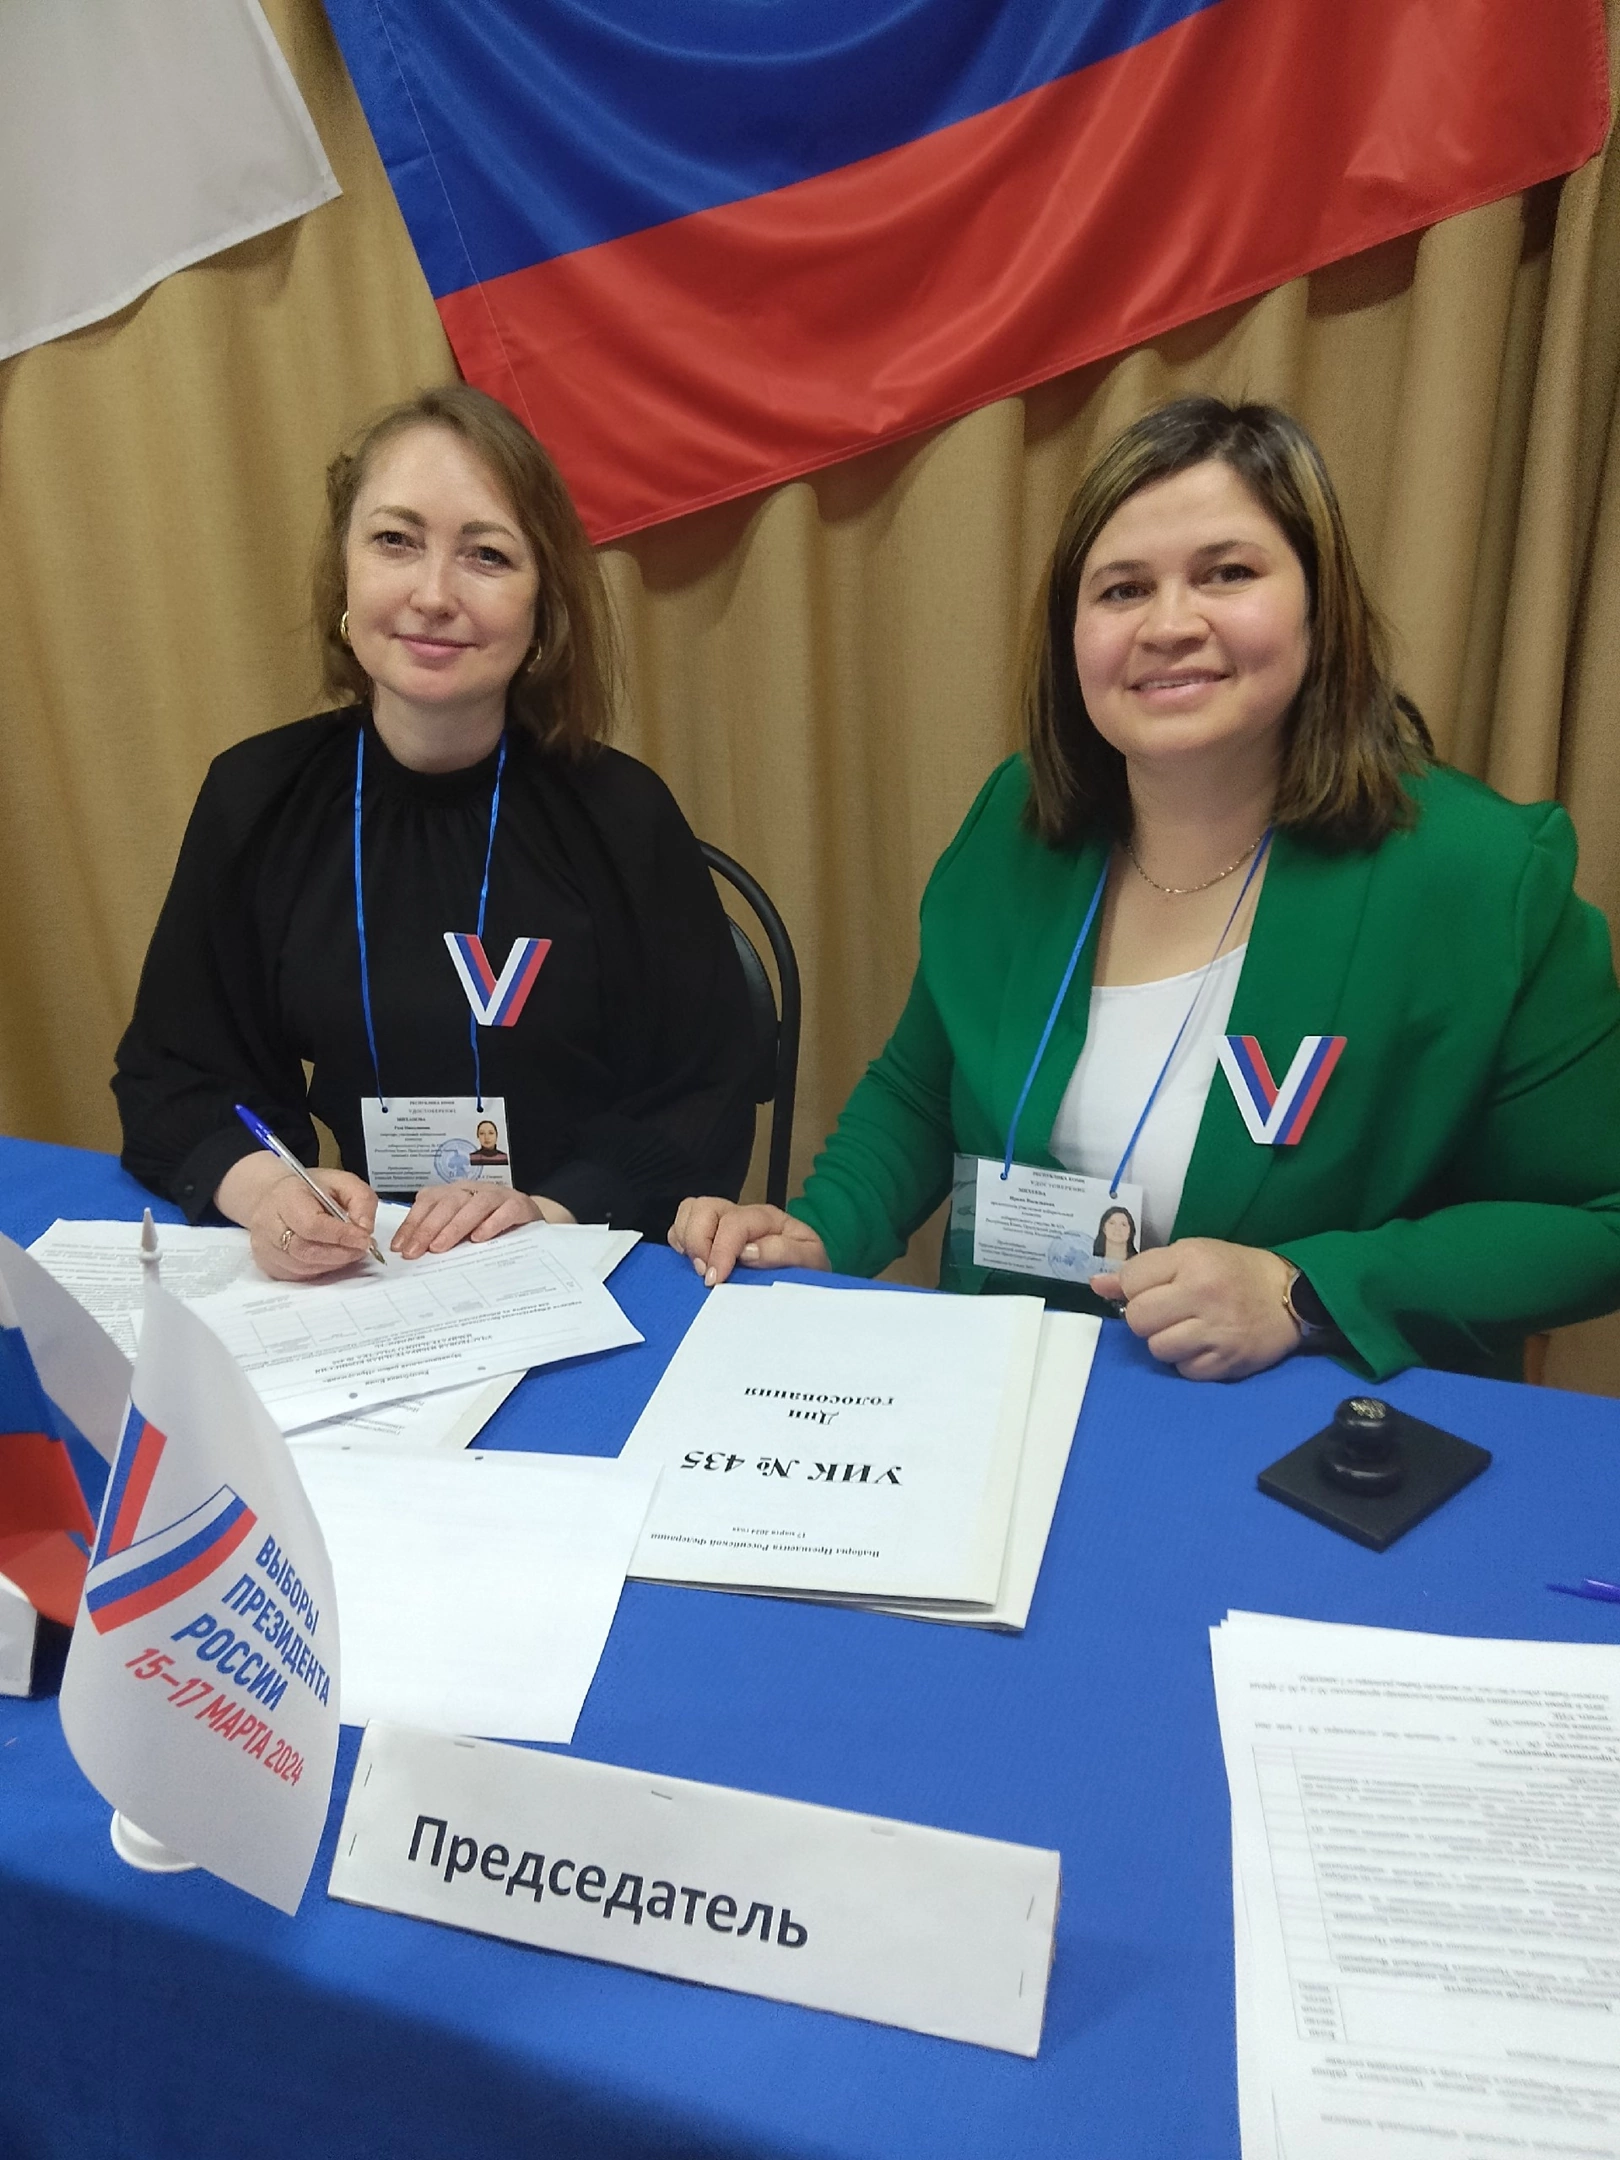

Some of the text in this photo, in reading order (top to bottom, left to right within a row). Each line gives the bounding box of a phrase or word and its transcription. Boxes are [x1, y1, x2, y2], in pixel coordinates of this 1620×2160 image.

[744, 1387, 894, 1406] голосования
[788, 1409, 839, 1425] Дни
[680, 1450, 903, 1486] УИК № 435
[256, 1534, 319, 1636] ВЫБОРЫ
[651, 1533, 879, 1558] Выборы Президента Российской Федерации
[170, 1613, 288, 1712] РОССИИ
[221, 1573, 330, 1707] ПРЕЗИДЕНТА
[195, 1694, 273, 1759] МАРТА
[263, 1739, 304, 1787] 2024
[408, 1814, 809, 1949] Председатель
